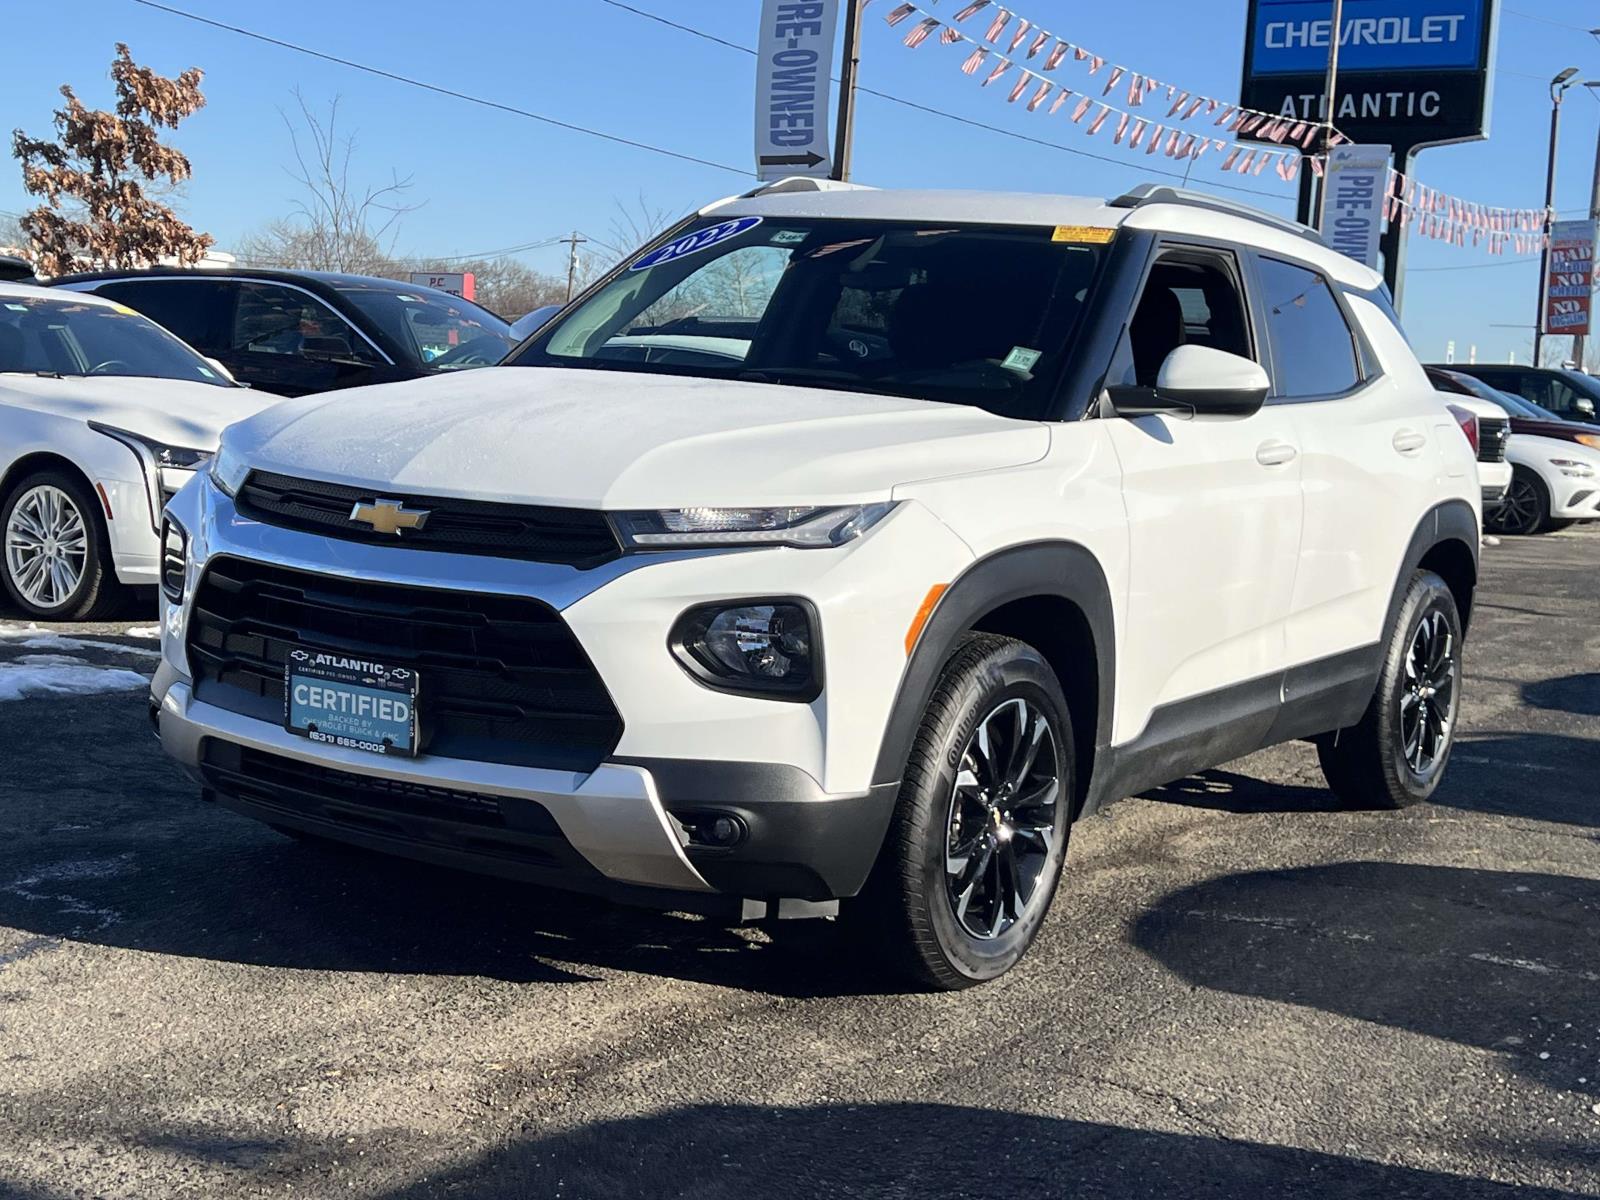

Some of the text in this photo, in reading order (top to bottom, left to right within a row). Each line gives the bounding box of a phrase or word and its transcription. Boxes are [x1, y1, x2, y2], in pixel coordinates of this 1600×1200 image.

[1264, 14, 1466, 49] CHEVROLET
[770, 0, 825, 147] RE-OWNED
[1332, 175, 1375, 265] PRE-OWN
[654, 221, 740, 264] 2022
[1551, 247, 1592, 263] BAD
[1556, 271, 1585, 287] NO
[1552, 300, 1581, 315] NO
[316, 653, 384, 675] ATLANTIC
[293, 684, 409, 723] CERTIFIED
[328, 713, 373, 728] BACKED BY
[309, 731, 335, 744] (631)
[349, 726, 373, 736] BUICK
[374, 730, 380, 738] &
